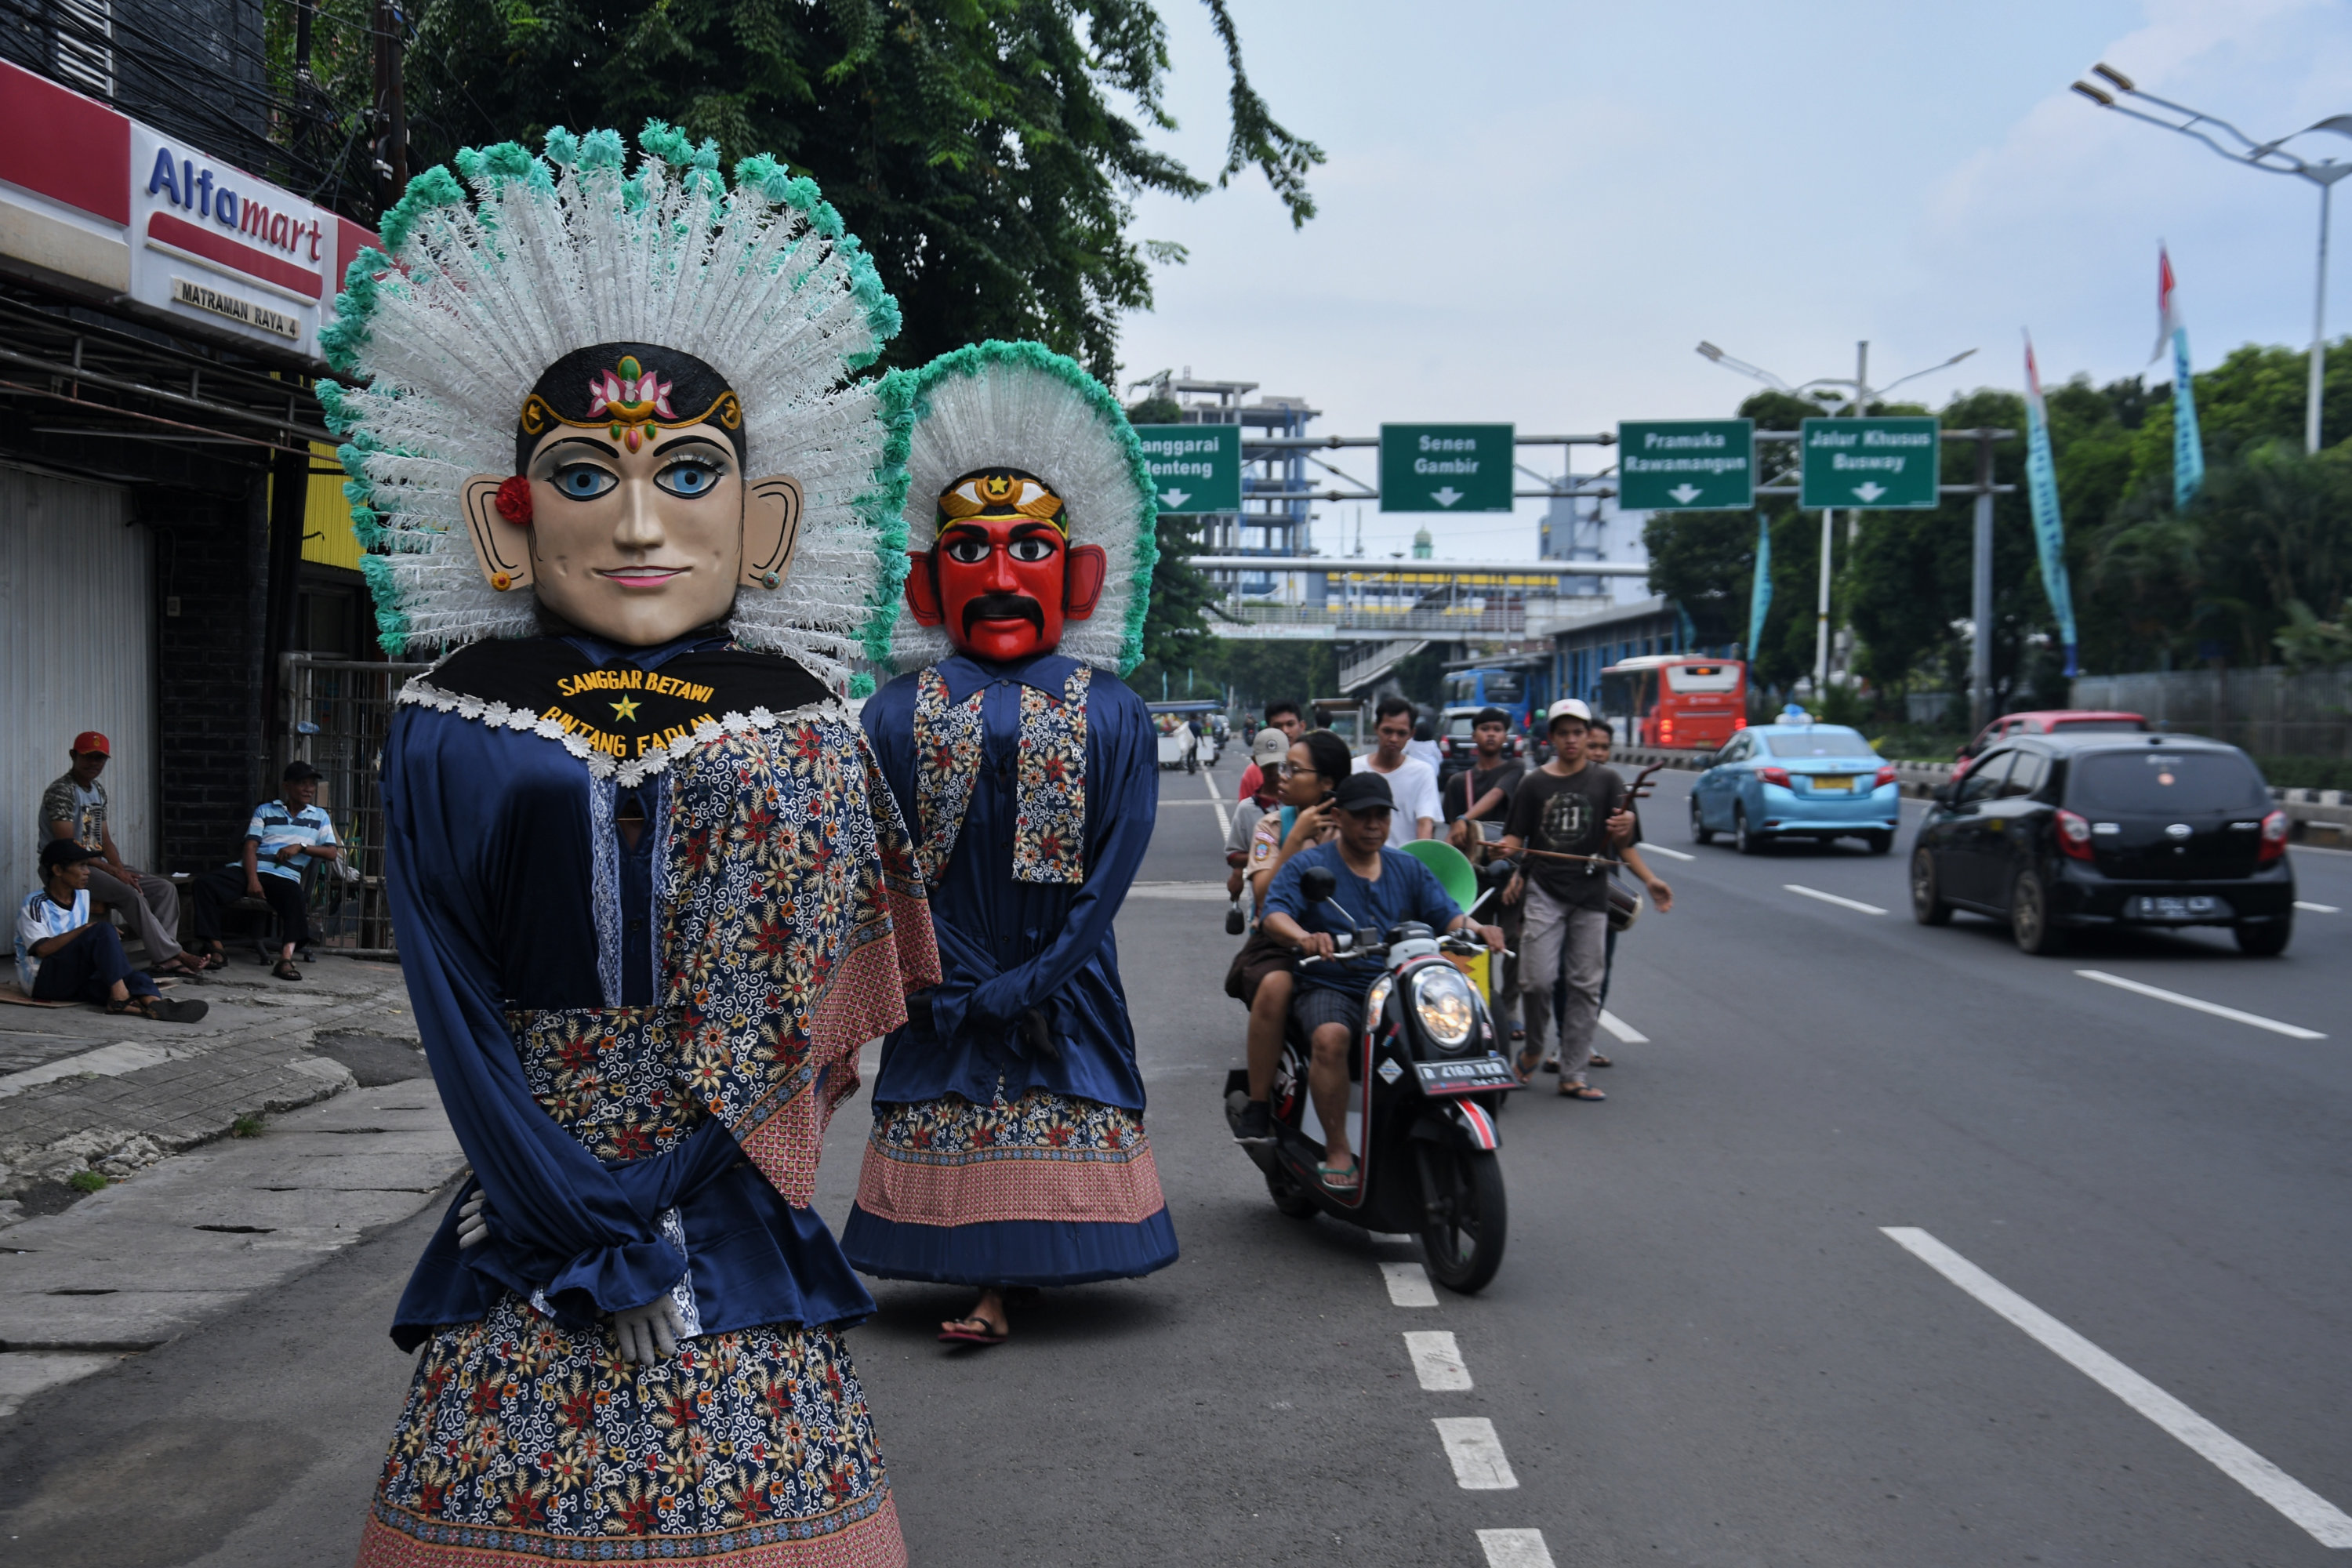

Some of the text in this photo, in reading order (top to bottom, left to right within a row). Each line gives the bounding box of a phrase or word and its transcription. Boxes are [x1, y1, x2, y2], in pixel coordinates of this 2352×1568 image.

[149, 147, 322, 261] Alfamart
[182, 282, 296, 336] MATRAMAN RAYA 4
[1142, 436, 1219, 456] anggarai
[1419, 434, 1476, 452] Senen
[1644, 431, 1726, 449] Pramuka
[1414, 457, 1479, 474] Gambir
[1624, 456, 1747, 474] Rawamangun
[1832, 452, 1906, 474] Busway
[557, 670, 715, 703] SANGGAR BETAWI
[539, 706, 626, 757] BINTANG
